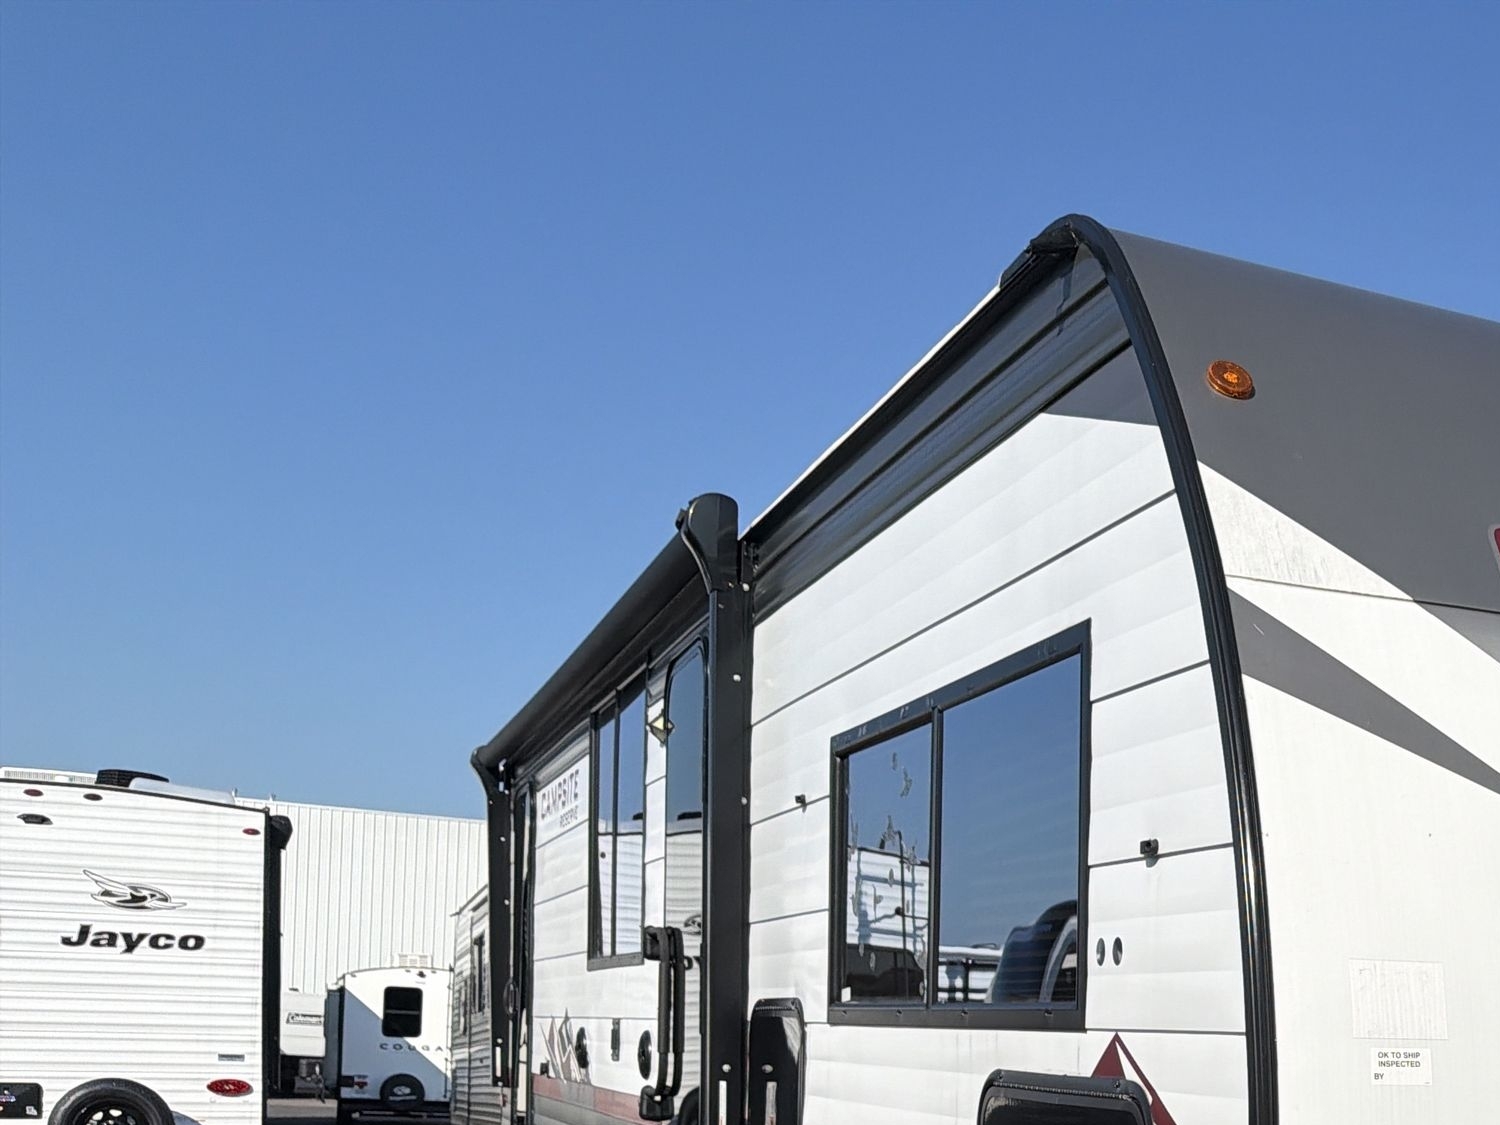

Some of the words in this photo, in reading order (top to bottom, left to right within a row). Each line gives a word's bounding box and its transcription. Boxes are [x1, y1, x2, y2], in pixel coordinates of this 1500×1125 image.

[541, 769, 579, 820] CAMPSITE
[60, 924, 206, 954] Jayco
[379, 1042, 444, 1053] COUGA
[1377, 1051, 1389, 1059] OK
[1391, 1051, 1402, 1059] TO
[1403, 1051, 1421, 1059] SHIP
[1378, 1060, 1421, 1068] INSPECTED
[1374, 1072, 1385, 1080] BY
